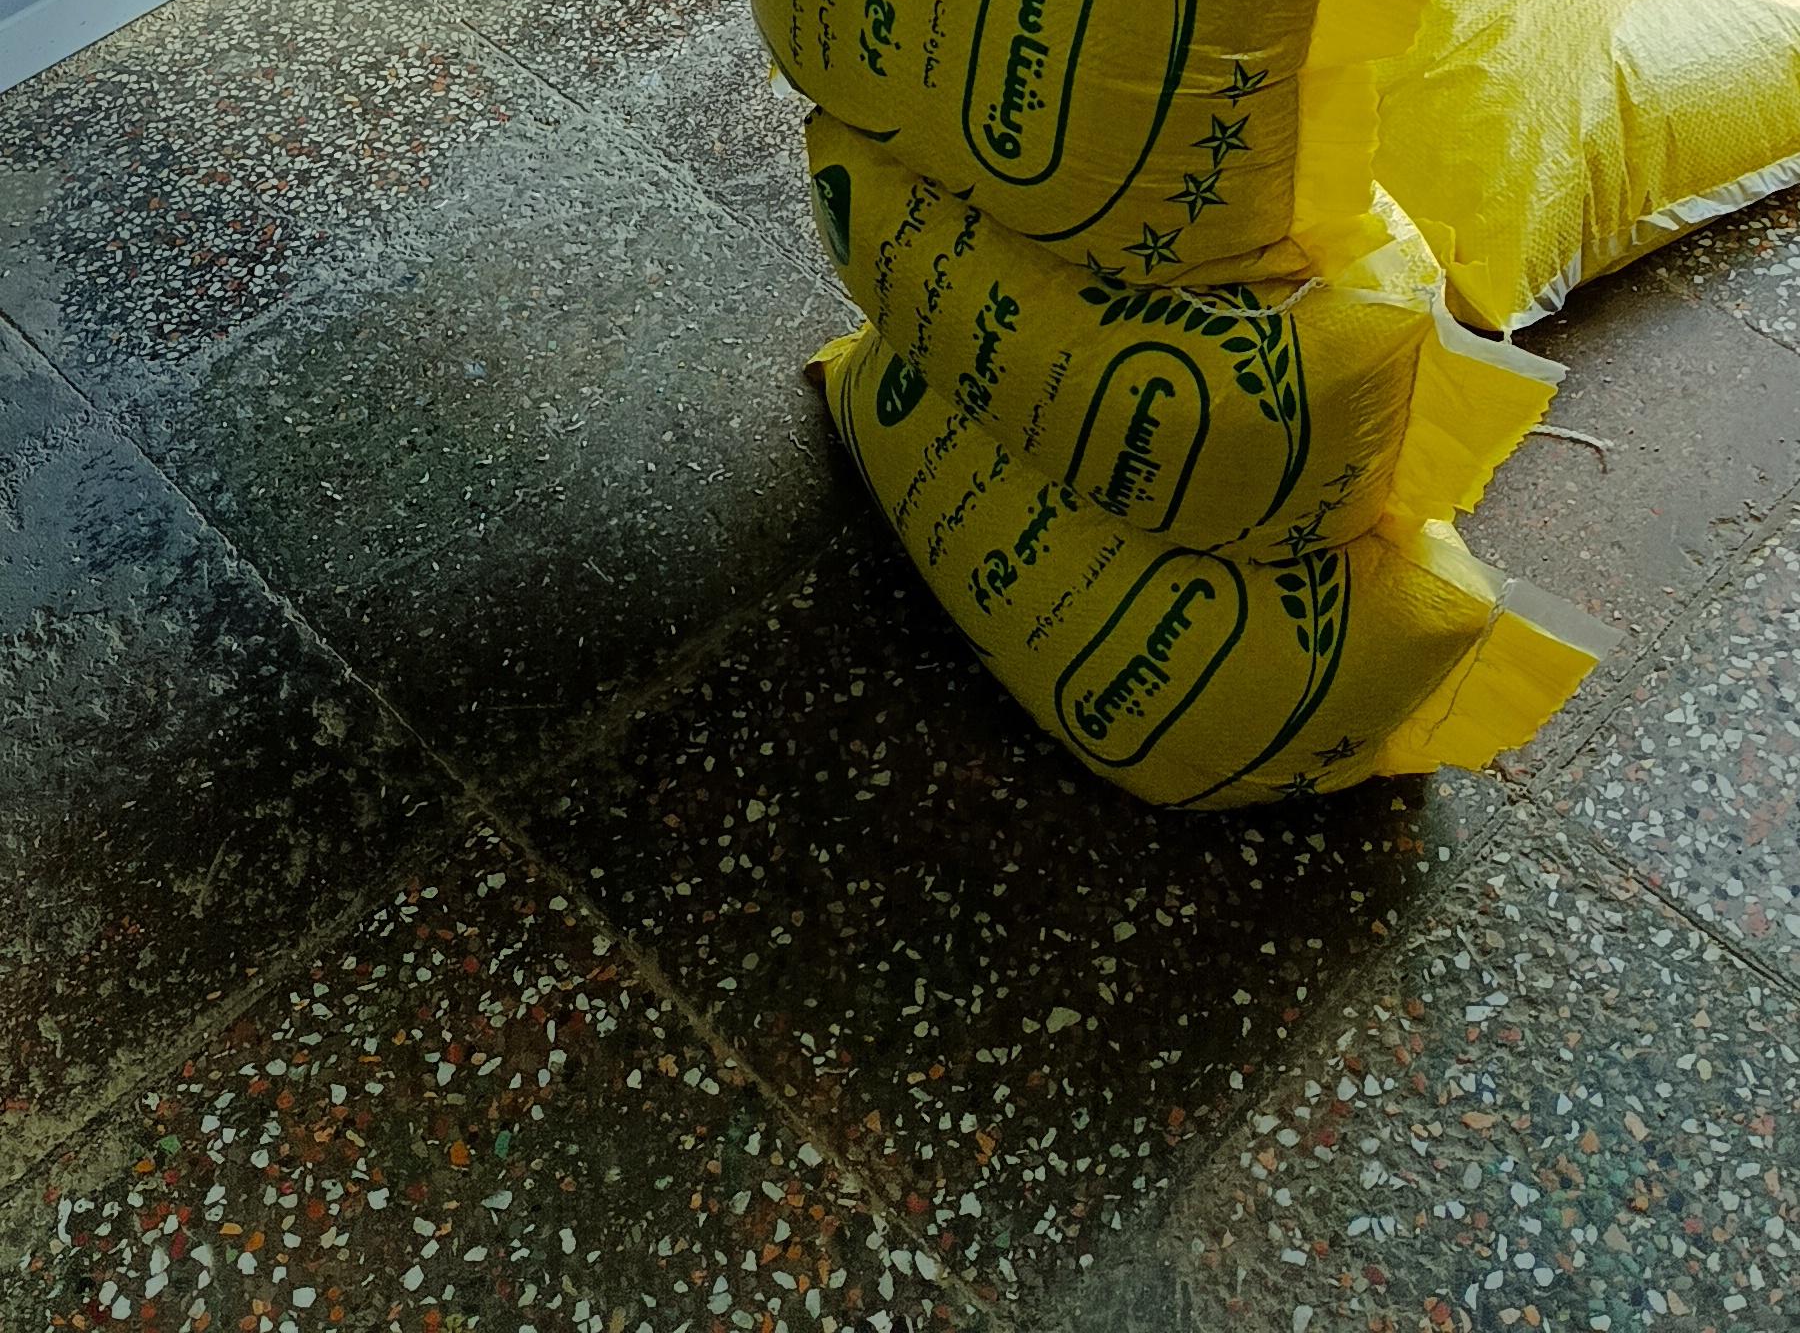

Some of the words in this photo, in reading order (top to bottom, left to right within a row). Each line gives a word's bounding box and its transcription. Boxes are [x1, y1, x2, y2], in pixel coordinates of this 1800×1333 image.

[817, 6, 836, 71] خوش
[922, 38, 940, 89] شماره
[922, 254, 952, 314] خوش
[953, 206, 980, 257] طعم
[1086, 377, 1175, 517] ویشتاسب
[971, 471, 985, 493] و
[967, 549, 1017, 617] برنج
[1073, 578, 1215, 741] ویشتاسب
